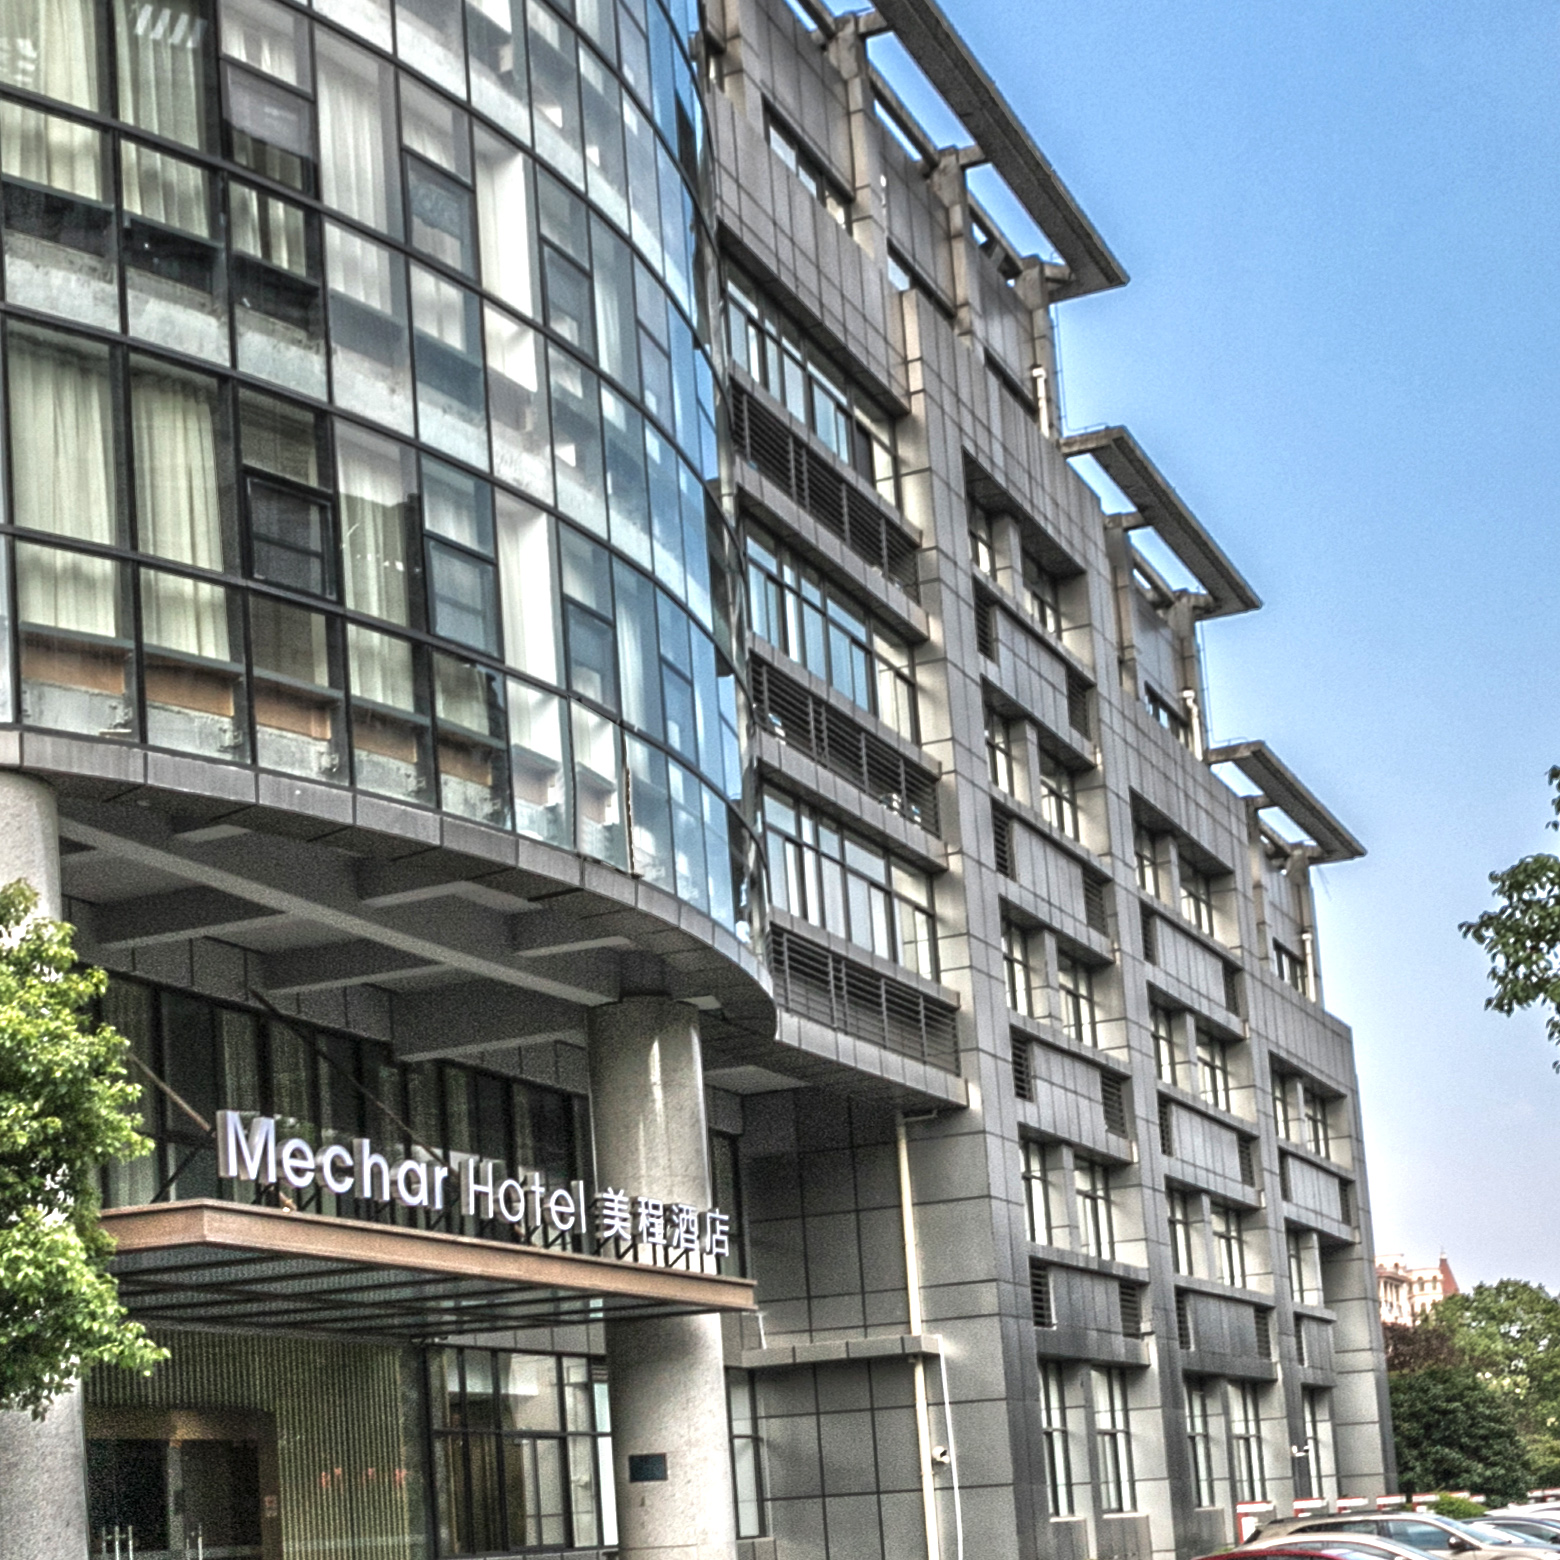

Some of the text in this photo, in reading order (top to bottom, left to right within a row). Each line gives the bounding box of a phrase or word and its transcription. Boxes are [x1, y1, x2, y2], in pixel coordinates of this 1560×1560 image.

[220, 1110, 587, 1233] Mechar Hotel
[601, 1186, 730, 1257] 美程酒店
